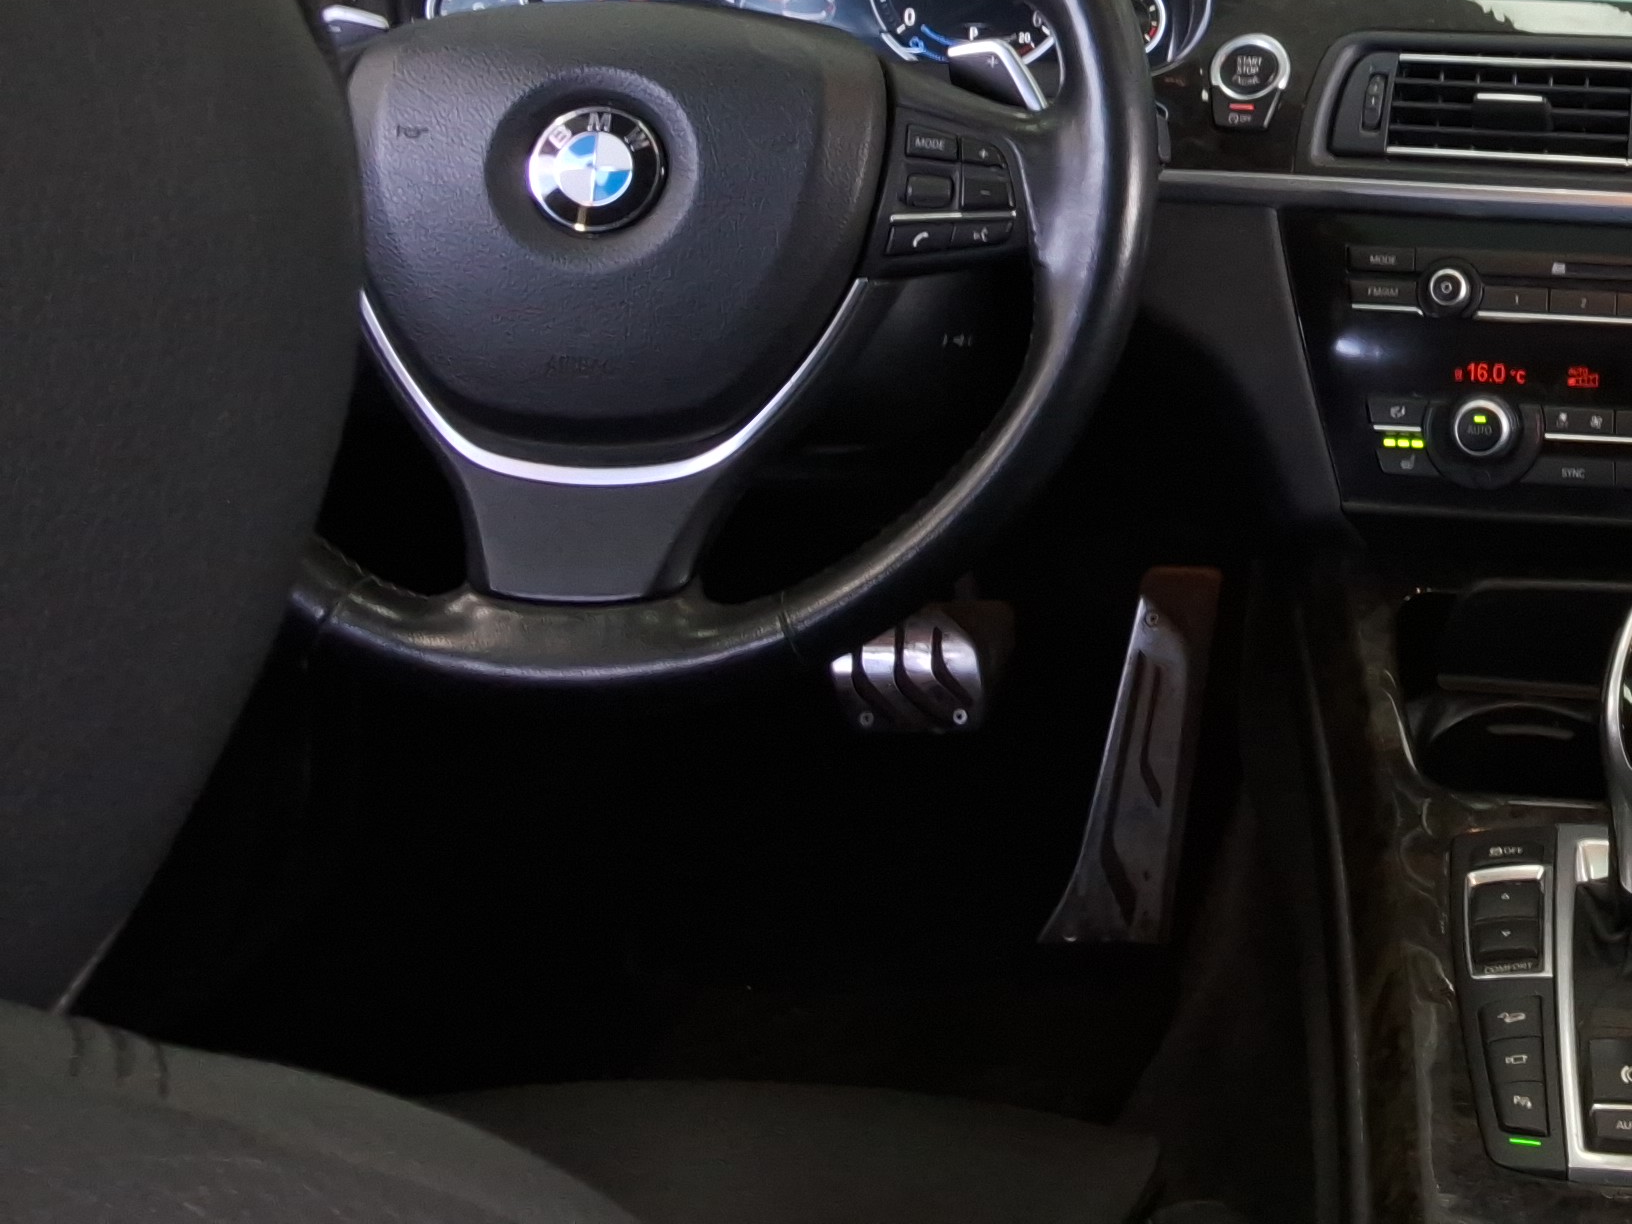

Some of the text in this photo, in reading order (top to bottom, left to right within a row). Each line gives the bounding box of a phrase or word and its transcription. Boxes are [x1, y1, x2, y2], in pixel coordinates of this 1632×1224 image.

[904, 7, 916, 26] 0
[969, 27, 979, 41] P
[549, 112, 650, 153] BMW
[915, 137, 945, 151] MODE
[1369, 254, 1397, 266] MODE
[1466, 362, 1506, 384] 16.0
[1467, 426, 1493, 436] AUTO
[1561, 467, 1586, 479] SYNC
[1504, 846, 1523, 855] OFF
